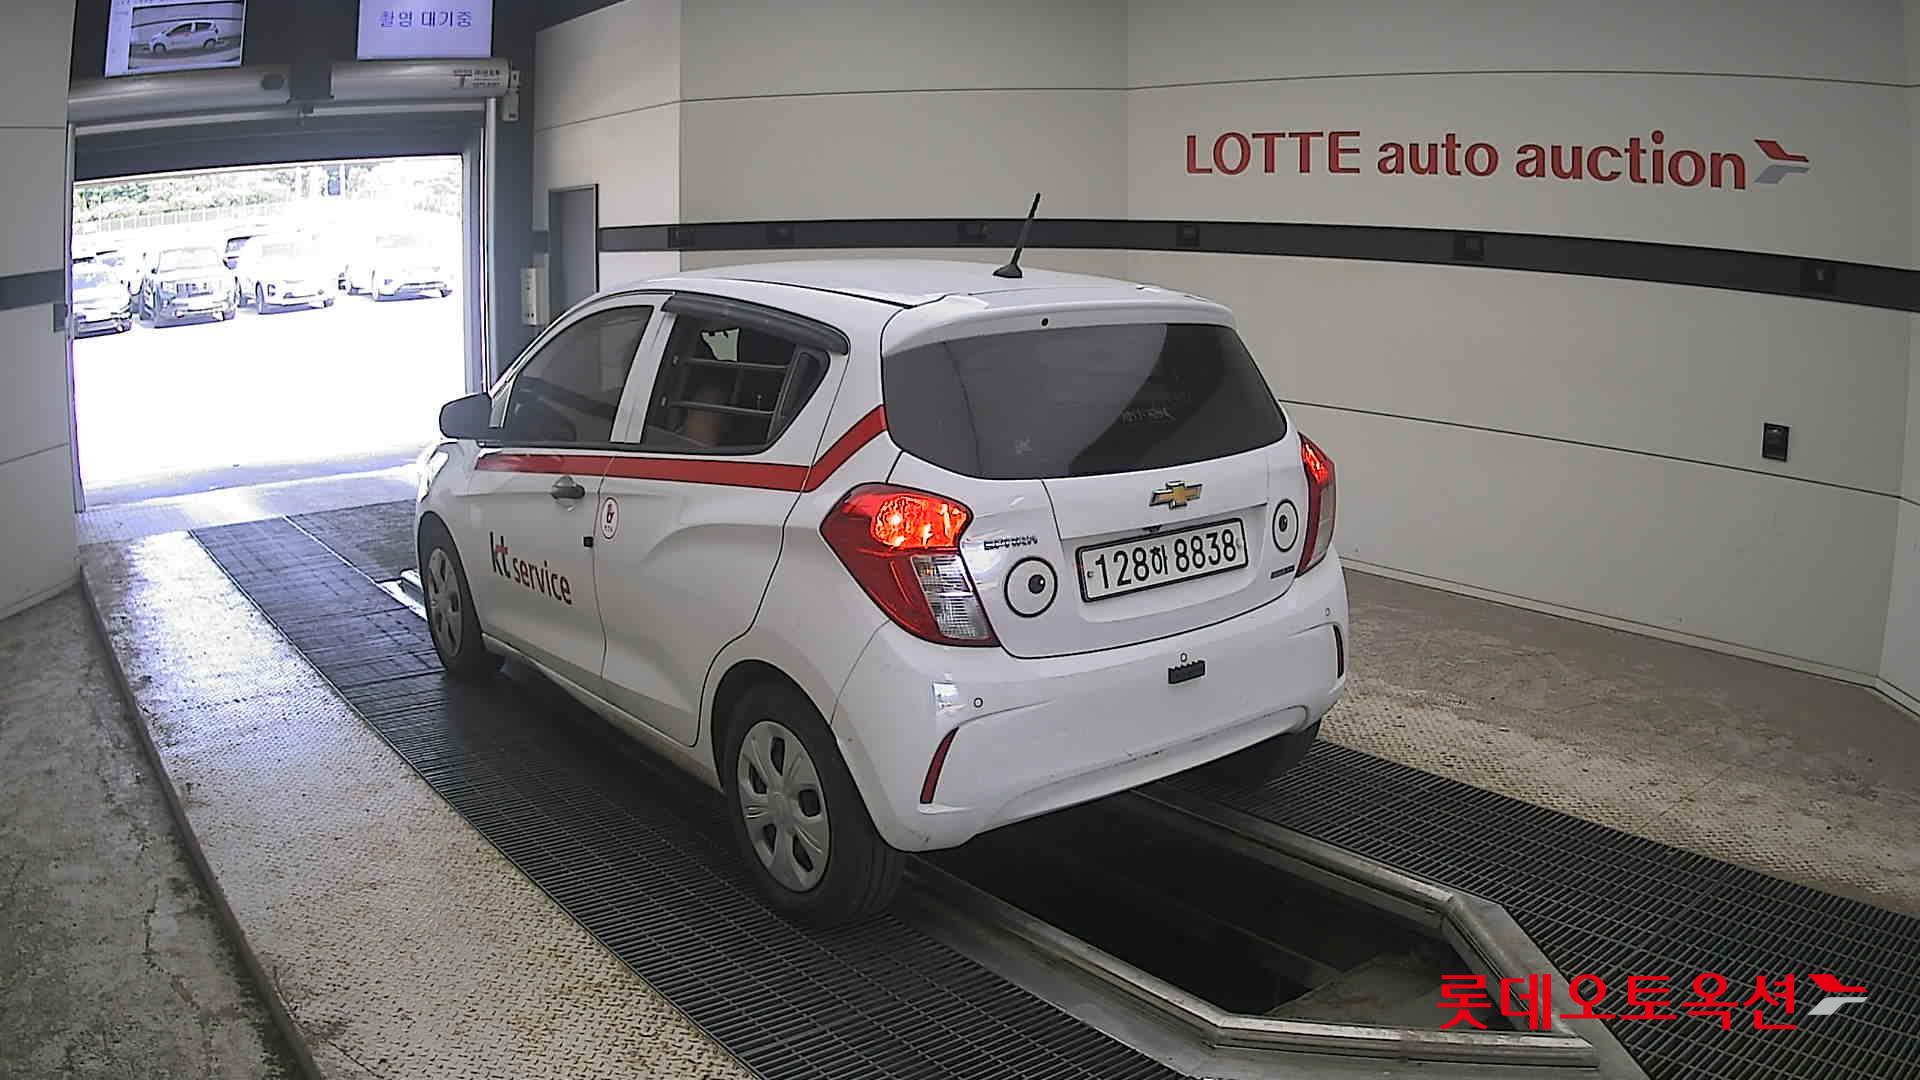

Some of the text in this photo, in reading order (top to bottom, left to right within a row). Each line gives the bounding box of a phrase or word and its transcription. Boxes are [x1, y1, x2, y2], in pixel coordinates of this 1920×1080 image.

[420, 10, 471, 28] 대기중
[1185, 130, 1746, 190] LOTTE auto auction
[490, 531, 572, 605] kt service
[1095, 528, 1238, 589] 128하 8838
